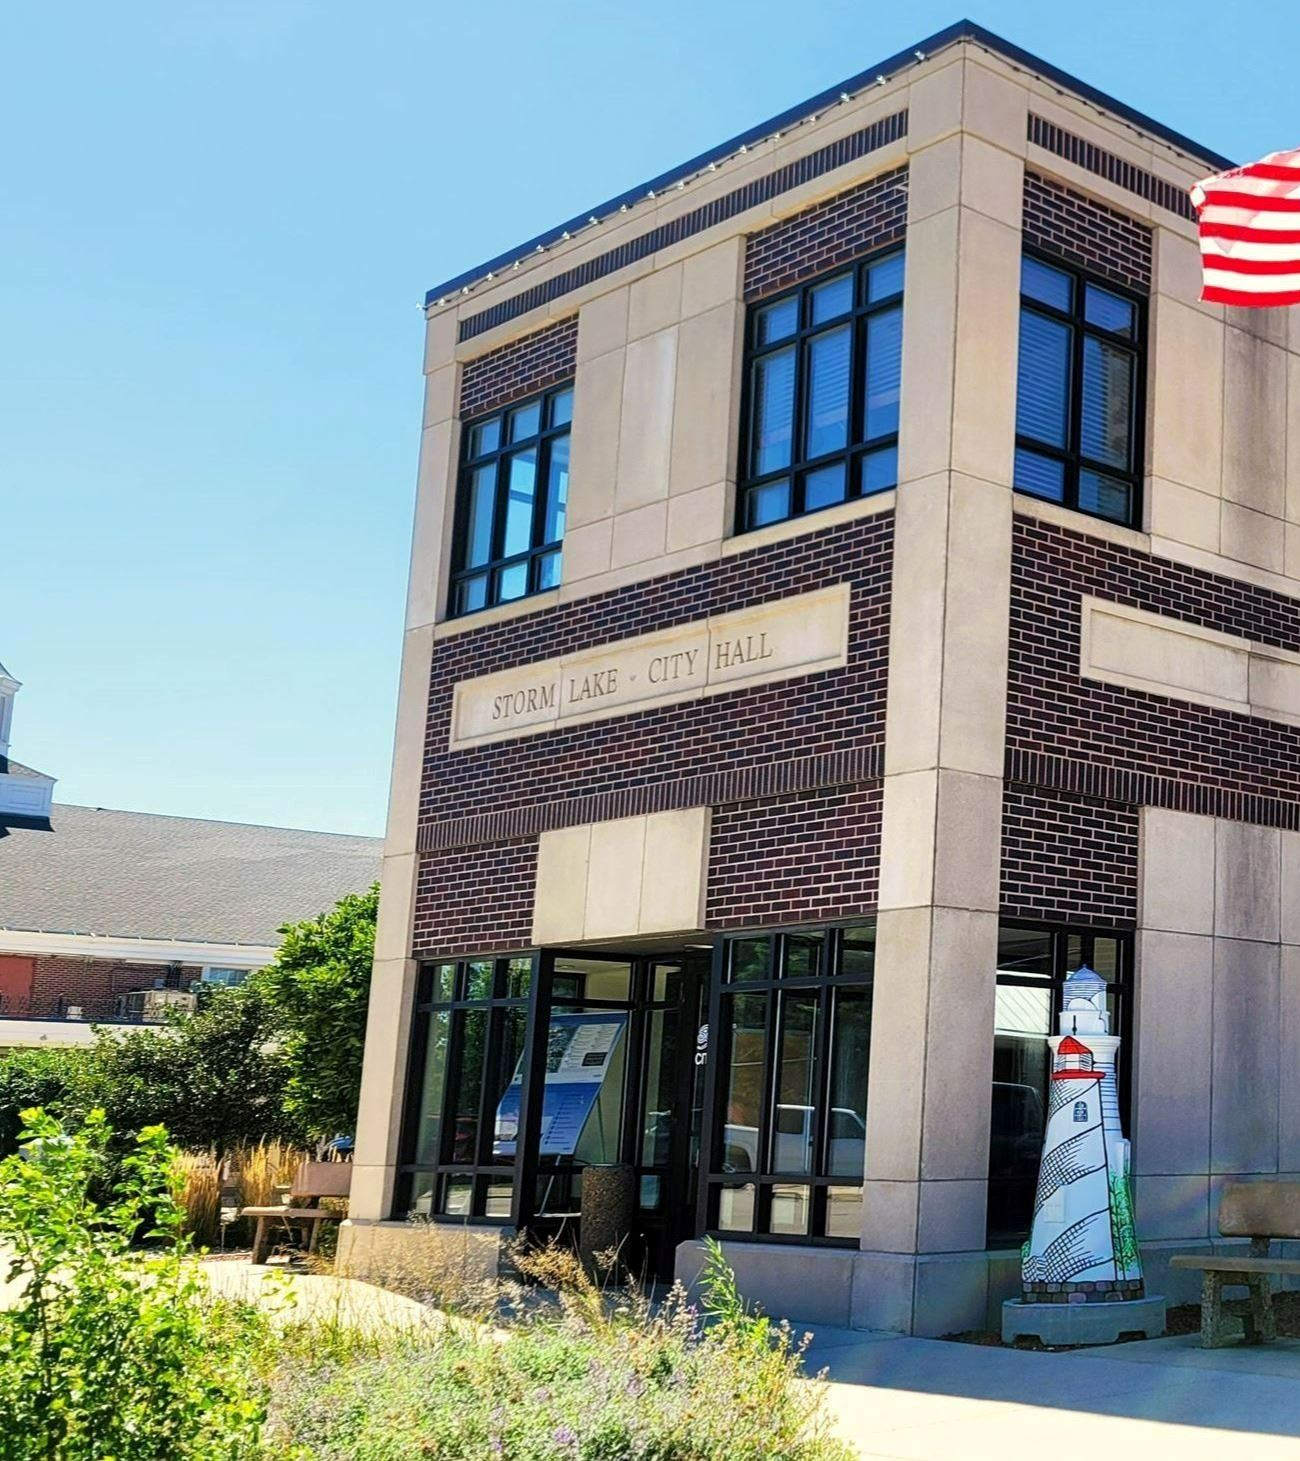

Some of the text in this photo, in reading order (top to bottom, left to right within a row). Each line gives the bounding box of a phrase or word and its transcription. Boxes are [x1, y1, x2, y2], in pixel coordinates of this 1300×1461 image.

[492, 632, 774, 720] STORM LAKE CITY HALL
